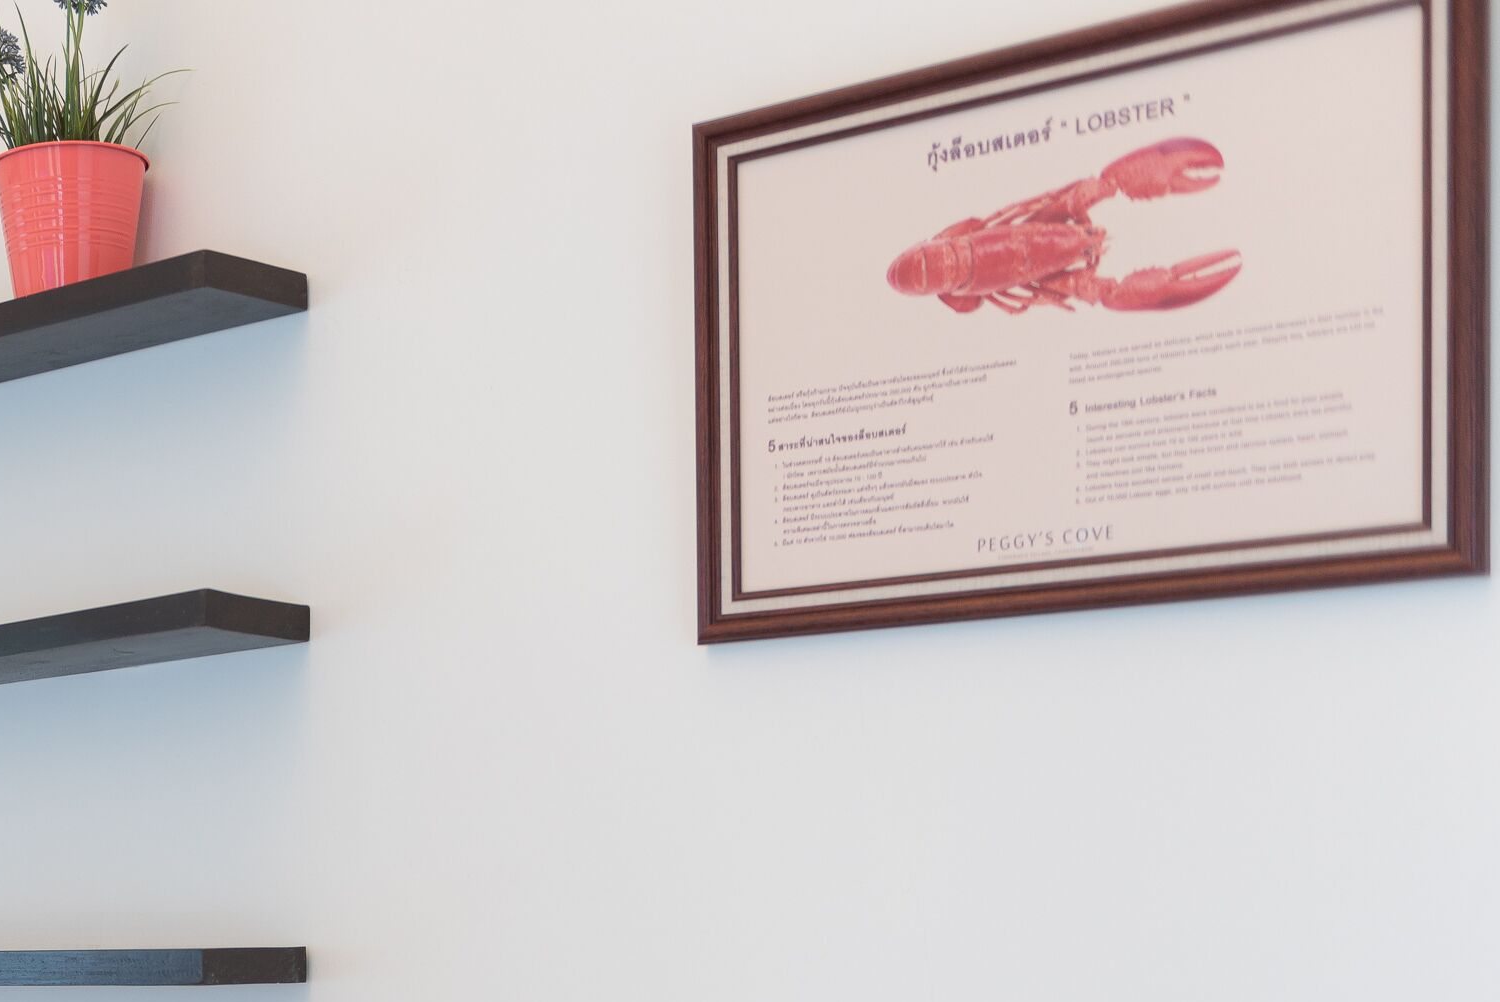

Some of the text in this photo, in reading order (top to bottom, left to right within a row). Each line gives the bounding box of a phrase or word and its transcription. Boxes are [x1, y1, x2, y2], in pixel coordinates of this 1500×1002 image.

[1075, 96, 1175, 135] LOBSTER
[977, 524, 1114, 552] PEGGY'S COVE
